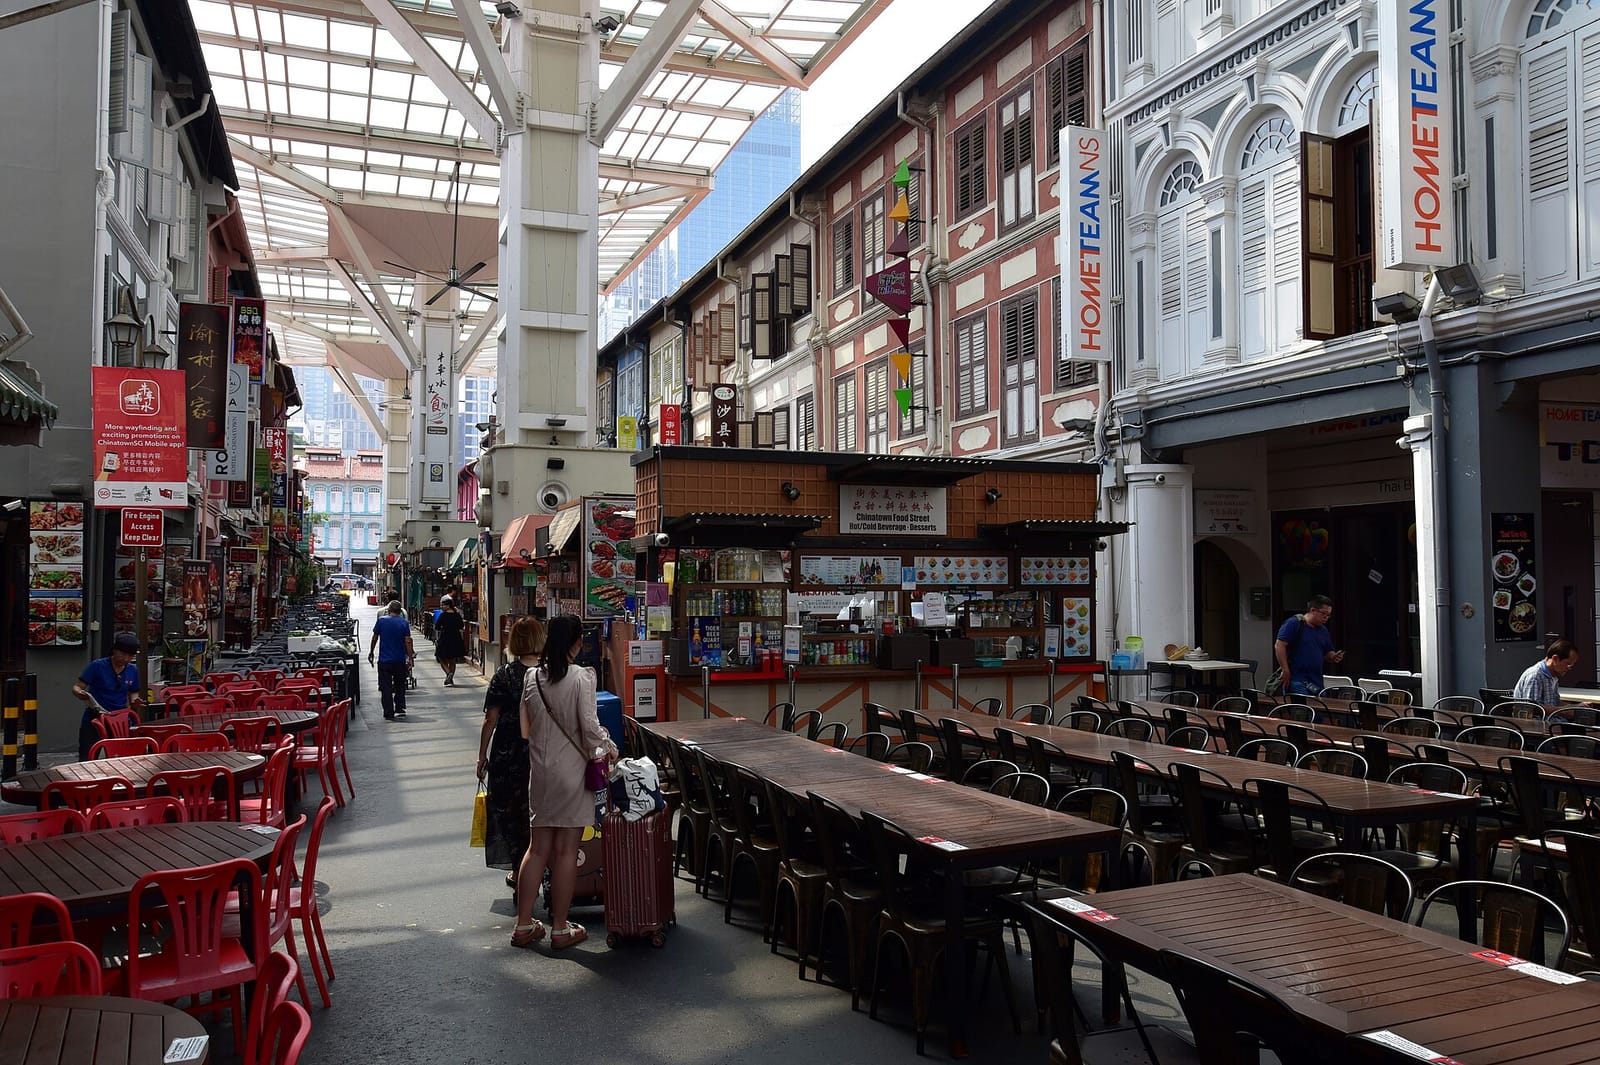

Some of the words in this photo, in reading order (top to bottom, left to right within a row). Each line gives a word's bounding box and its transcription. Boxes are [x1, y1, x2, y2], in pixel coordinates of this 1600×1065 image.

[125, 424, 163, 432] wayfinding
[102, 431, 129, 439] exciting
[125, 511, 138, 519] Fire
[139, 511, 160, 521] Engine
[856, 513, 892, 522] Chinatown
[893, 514, 909, 522] Food
[910, 514, 930, 523] Street
[131, 522, 154, 530] Access
[849, 522, 877, 531] Hot/Cold
[878, 522, 906, 531] Beverage
[910, 523, 937, 532] Desserts
[125, 533, 141, 542] Keep
[141, 533, 160, 542] Clear
